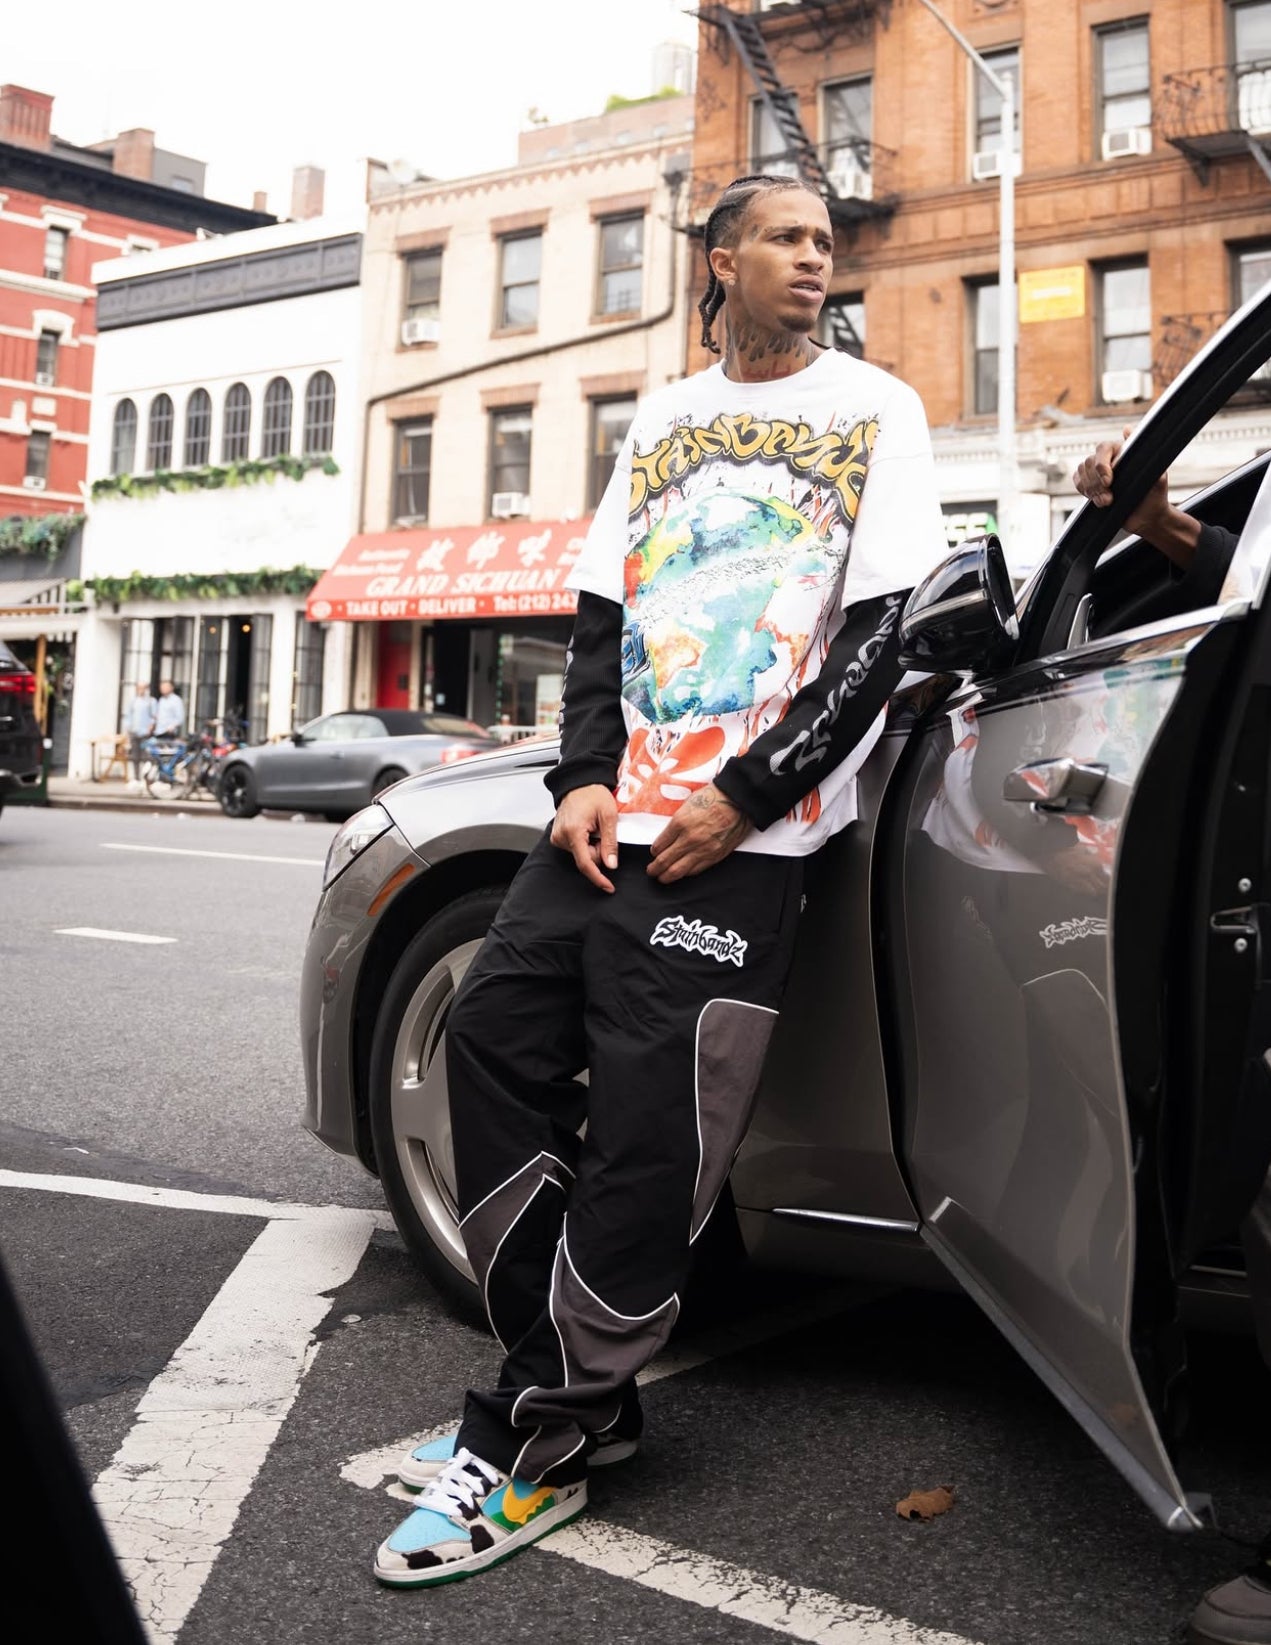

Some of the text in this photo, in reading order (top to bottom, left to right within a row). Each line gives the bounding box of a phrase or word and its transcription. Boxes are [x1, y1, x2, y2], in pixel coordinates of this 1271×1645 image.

[365, 568, 561, 597] GRAND SICHUAN
[346, 600, 379, 616] TAKE
[380, 599, 408, 615] OUT
[418, 596, 476, 615] DELIVER
